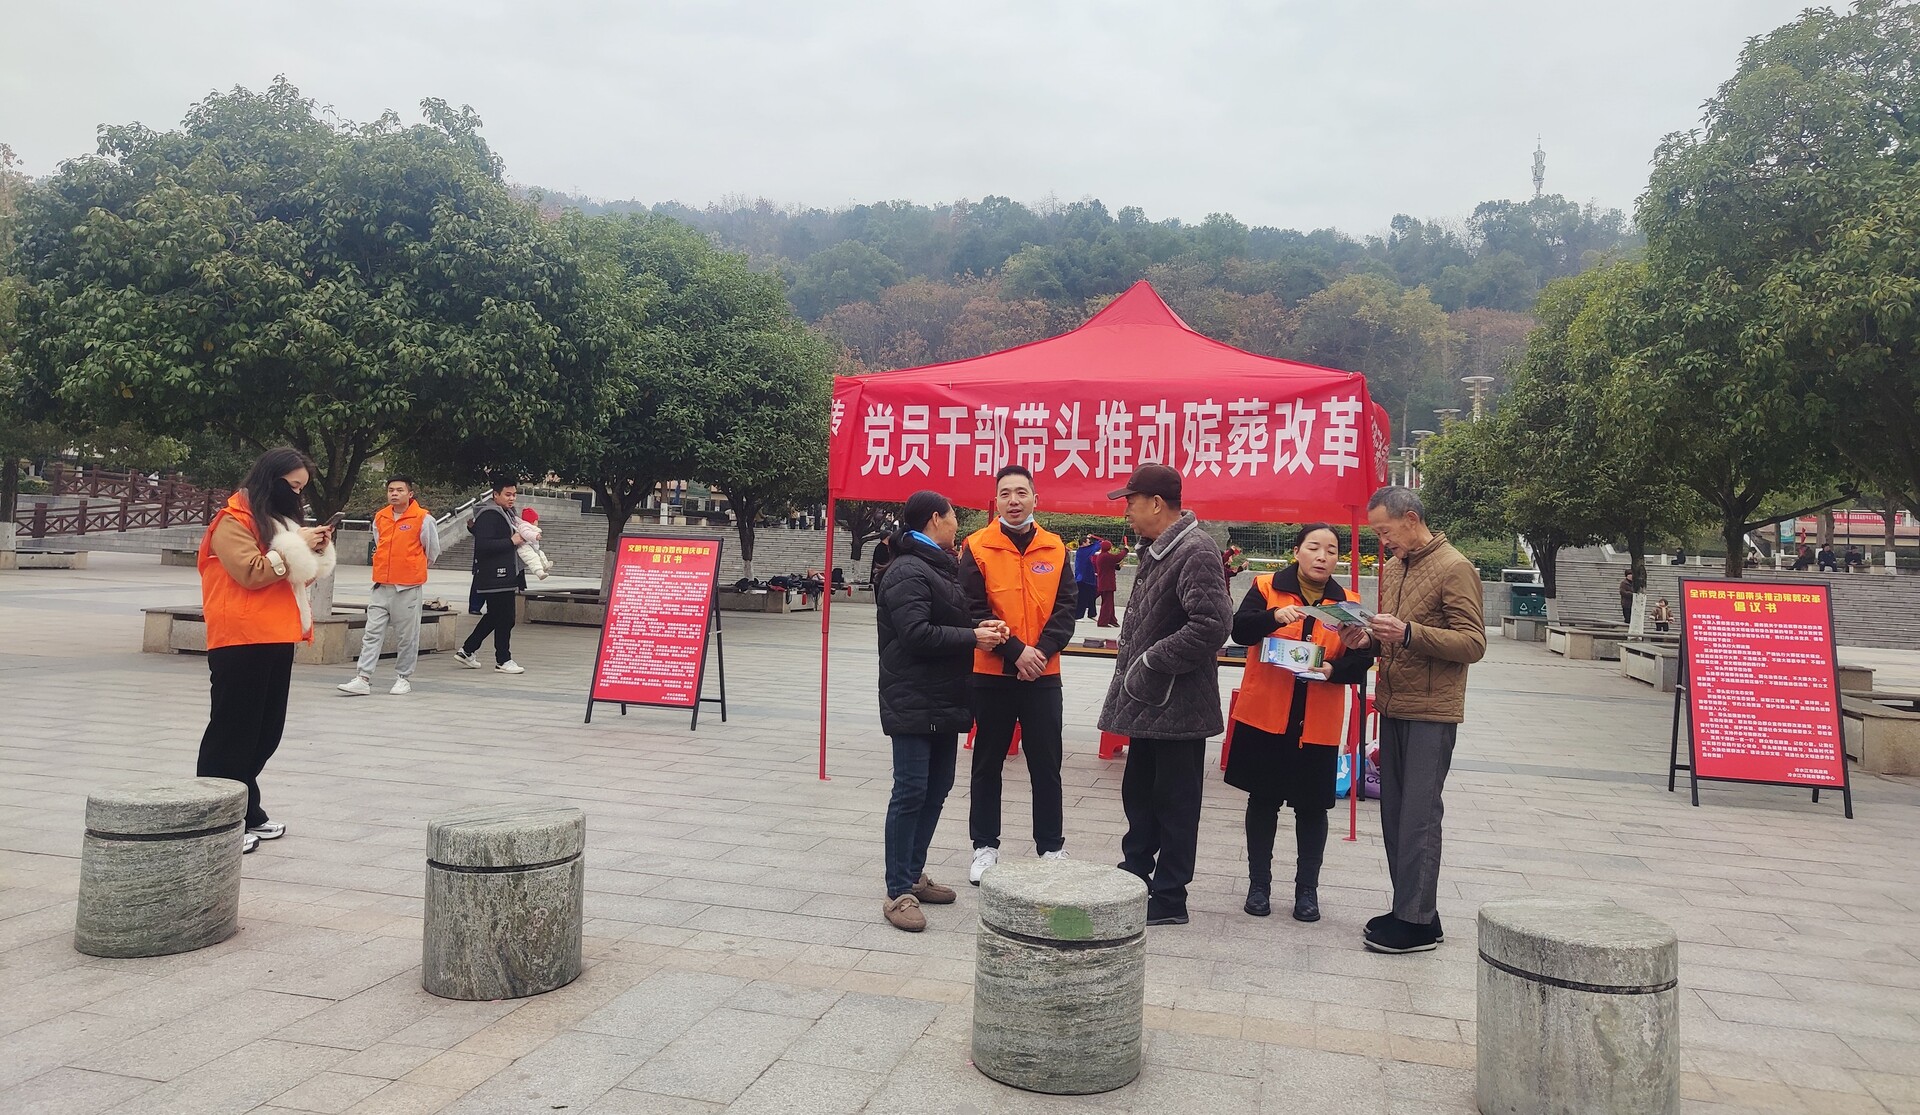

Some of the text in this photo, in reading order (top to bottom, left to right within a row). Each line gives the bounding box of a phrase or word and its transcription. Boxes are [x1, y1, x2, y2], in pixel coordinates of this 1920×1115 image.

[859, 395, 1363, 479] 党员干部带头推动殡葬改革
[652, 554, 682, 564] 倡议书
[1689, 589, 1821, 603] 全市党员干部带头推动殡葬改革
[1734, 600, 1777, 613] 倡议书
